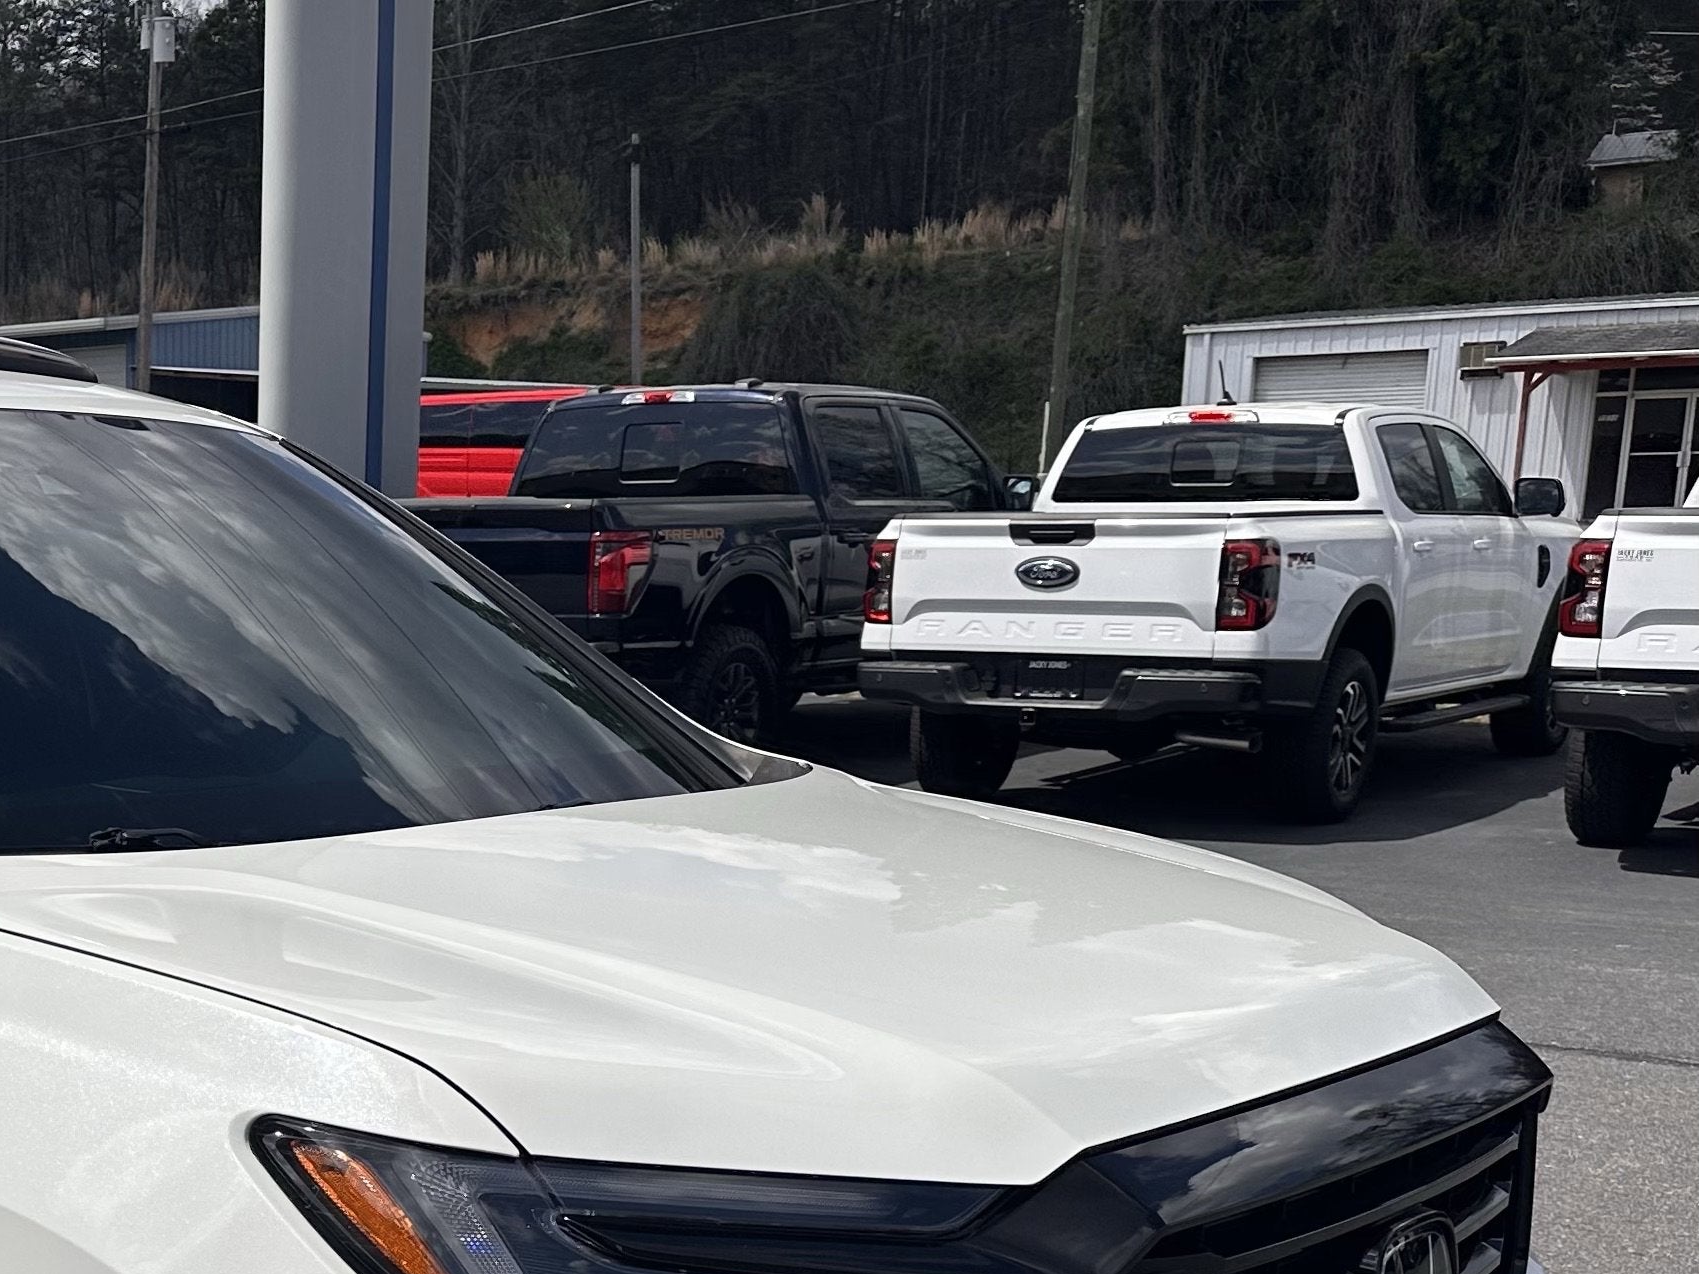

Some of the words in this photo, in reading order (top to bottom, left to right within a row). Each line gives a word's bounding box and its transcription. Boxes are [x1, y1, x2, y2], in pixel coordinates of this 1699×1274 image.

[661, 528, 725, 541] TREMOR
[1287, 552, 1315, 568] FX4
[916, 619, 1182, 642] RANGER
